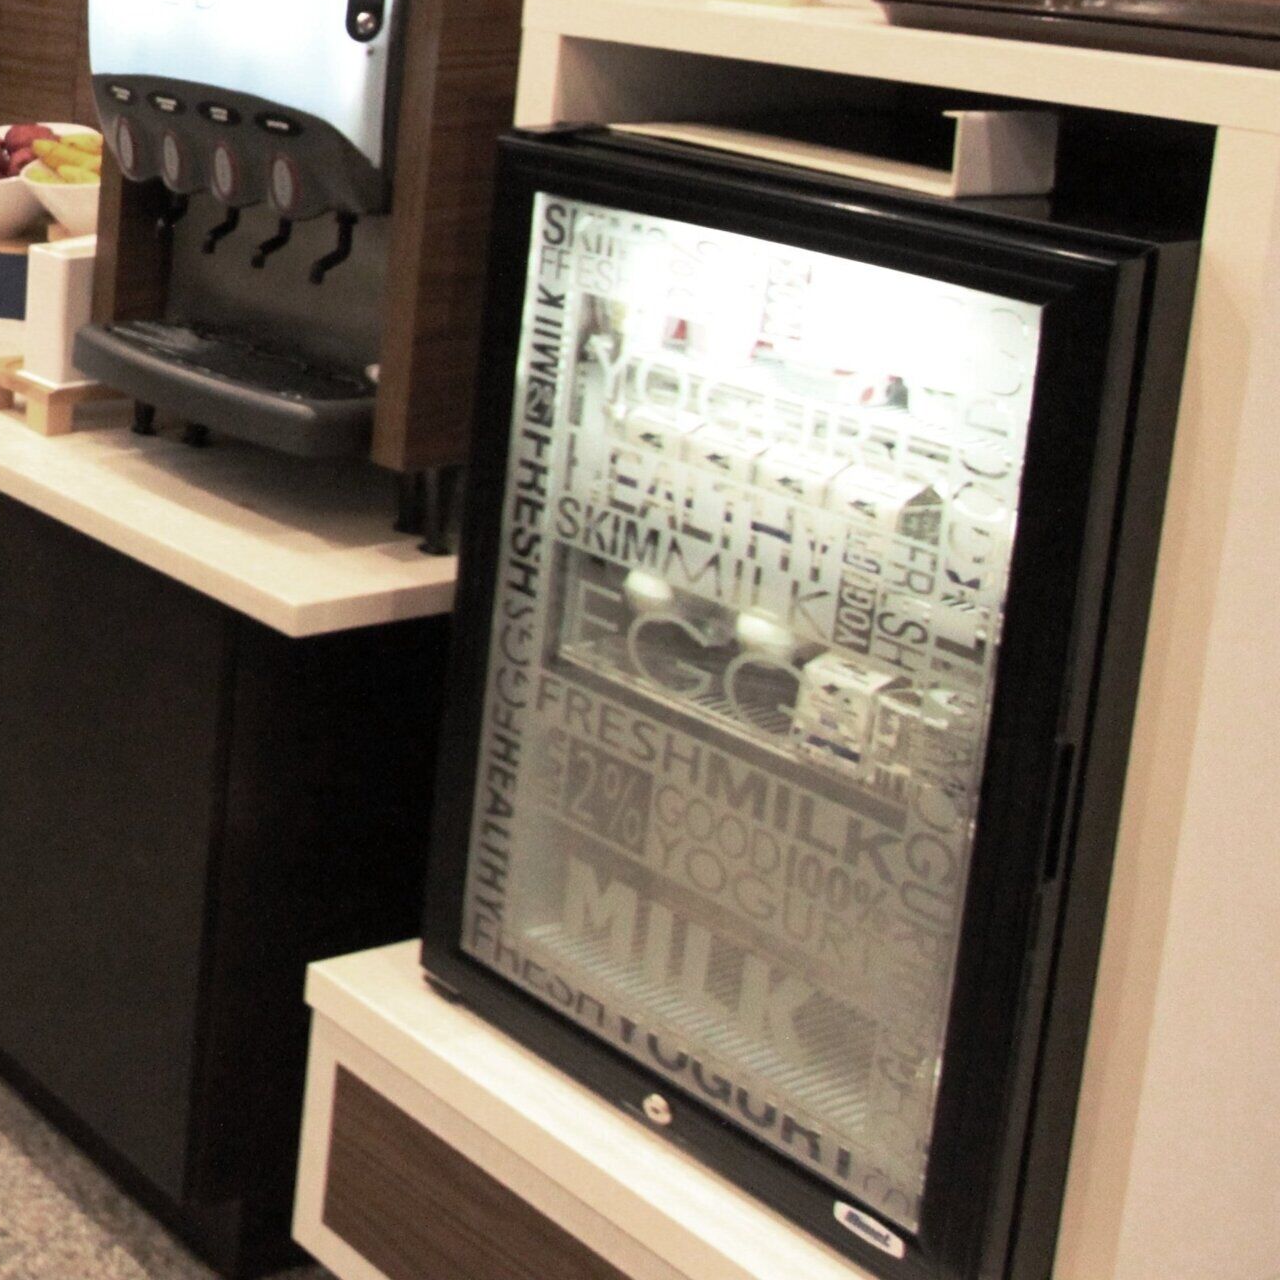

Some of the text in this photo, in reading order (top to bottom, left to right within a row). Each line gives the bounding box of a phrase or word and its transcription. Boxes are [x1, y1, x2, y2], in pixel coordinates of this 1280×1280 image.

[554, 490, 659, 572] SKIM
[536, 671, 703, 790] FRESH
[704, 750, 900, 885] MILK
[571, 747, 648, 854] 2%
[652, 777, 781, 880] GOOD
[562, 852, 819, 1074] MILK
